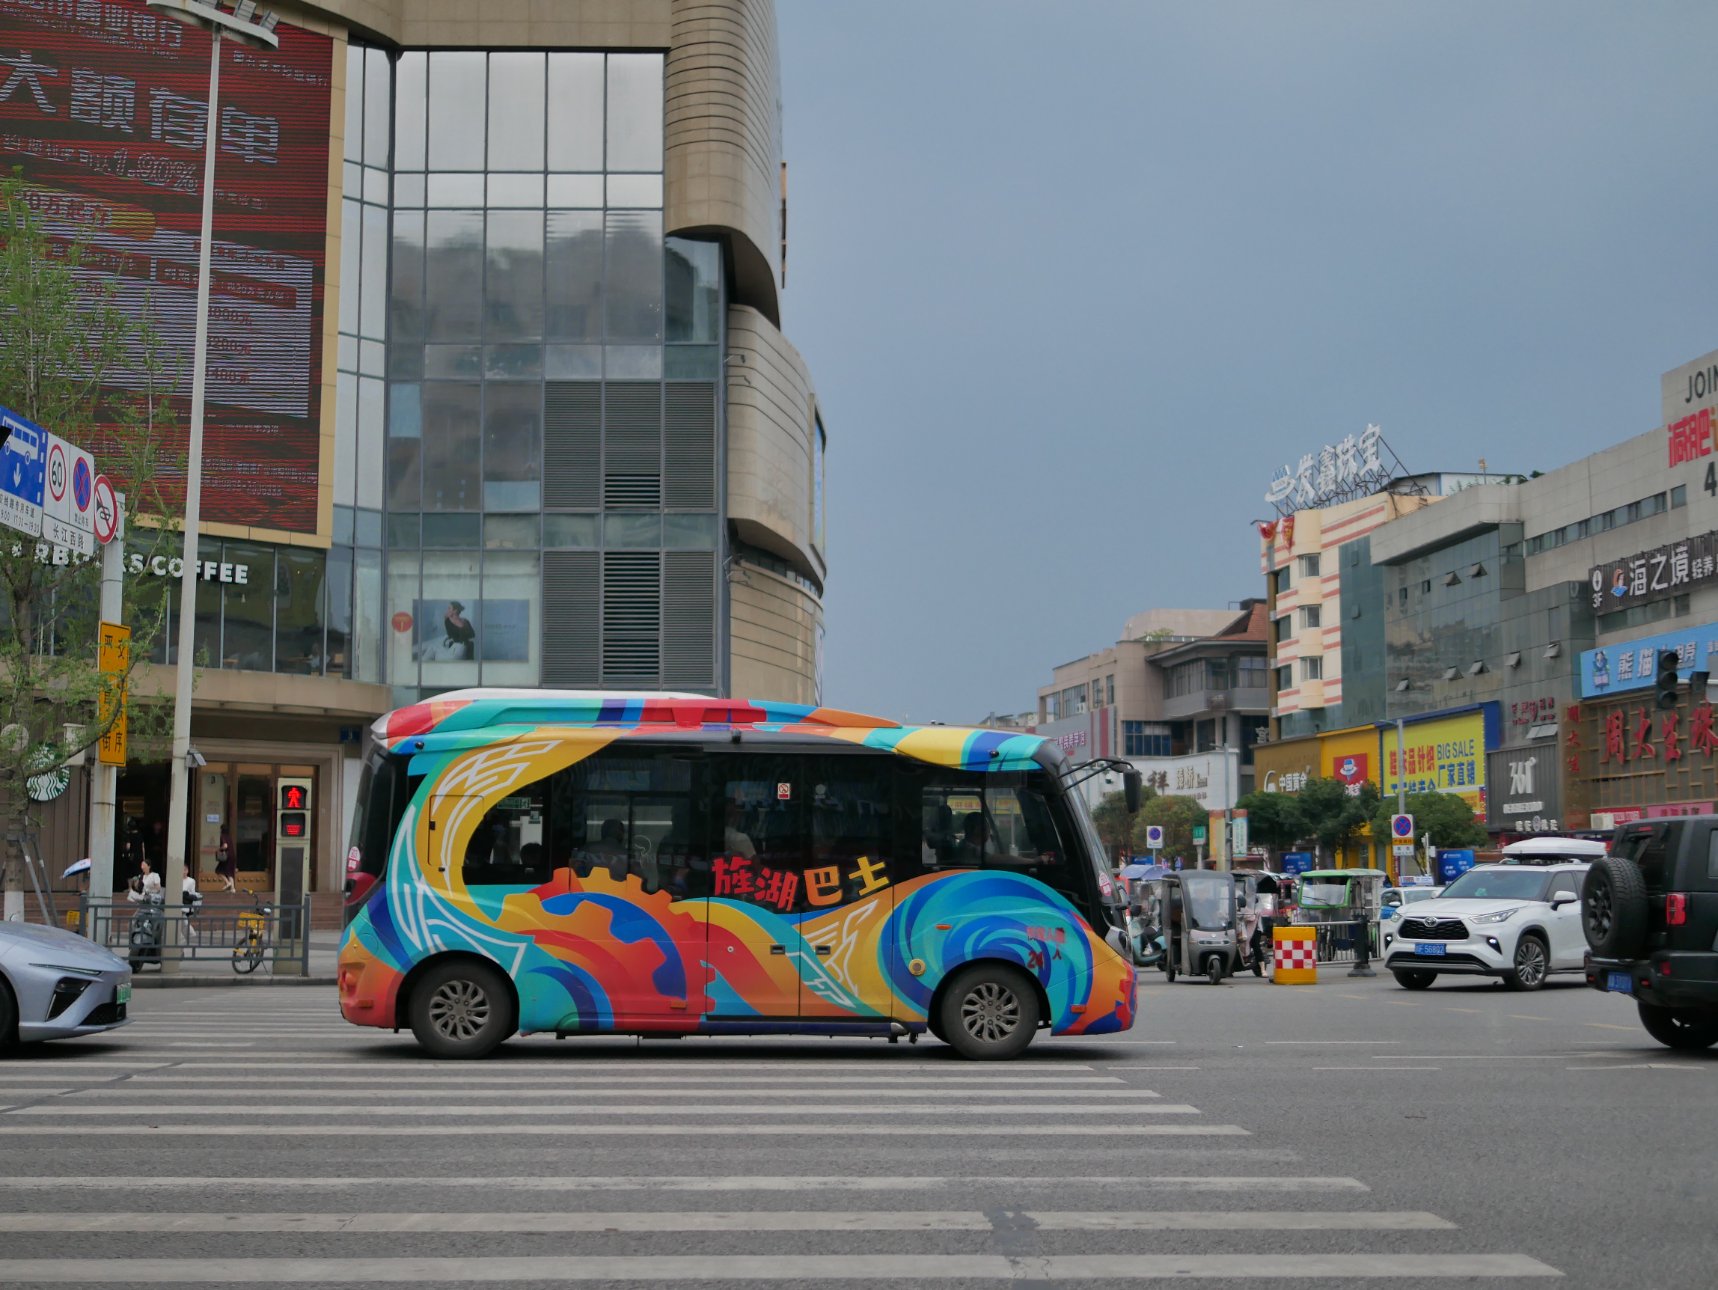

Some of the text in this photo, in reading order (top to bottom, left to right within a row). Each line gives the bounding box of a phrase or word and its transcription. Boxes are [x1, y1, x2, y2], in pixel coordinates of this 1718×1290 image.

[52, 460, 63, 486] 60
[53, 522, 85, 550] 长江西路
[1629, 546, 1690, 597] 海之境
[1437, 738, 1475, 761] BIG SALE
[1567, 705, 1582, 773] 周大生
[712, 855, 890, 912] 旌湖巴士
